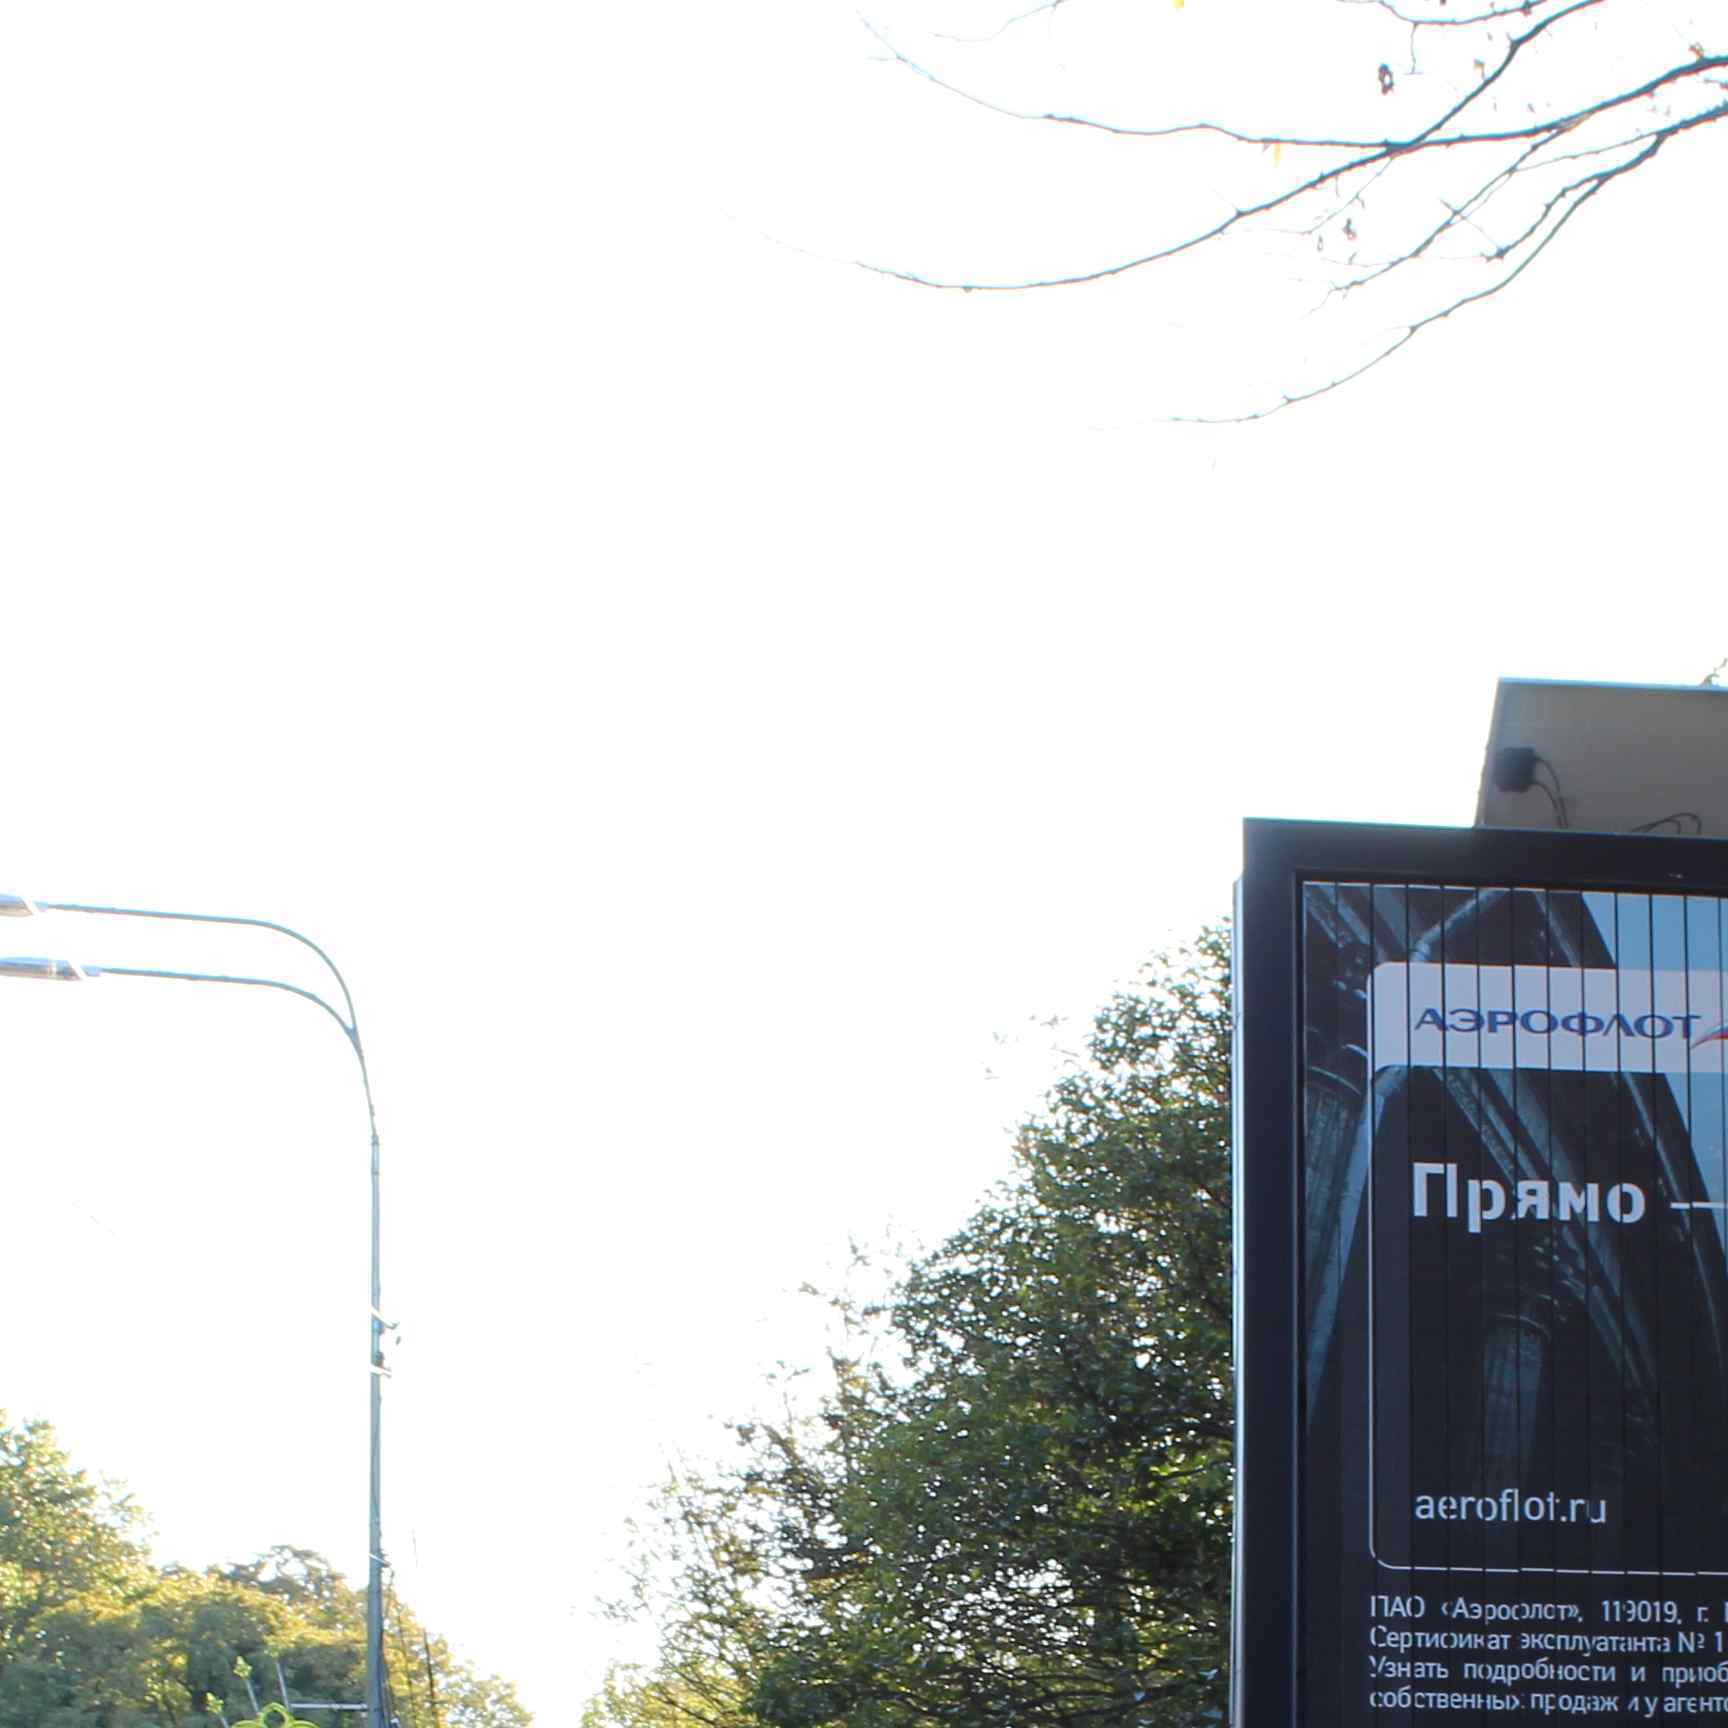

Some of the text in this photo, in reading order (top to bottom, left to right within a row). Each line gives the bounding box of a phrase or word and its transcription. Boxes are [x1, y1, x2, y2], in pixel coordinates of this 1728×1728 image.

[1414, 1007, 1701, 1041] АЭРОФЛОТ
[1412, 1162, 1646, 1234] Прямо
[1414, 1487, 1607, 1524] aeroflot.ru
[1370, 1596, 1425, 1618] ПАО
[1601, 1600, 1683, 1625] 119019,
[1696, 1606, 1709, 1622] г.
[1370, 1625, 1510, 1653] Сертификат
[1520, 1631, 1671, 1657] эксплуатанта
[1714, 1631, 1724, 1653] 1
[1370, 1656, 1449, 1679] Узнать
[1463, 1657, 1617, 1687] подробности
[1630, 1665, 1646, 1682] и
[1370, 1685, 1524, 1711] собственных
[1530, 1691, 1619, 1716] продаж
[1644, 1696, 1659, 1718] у
